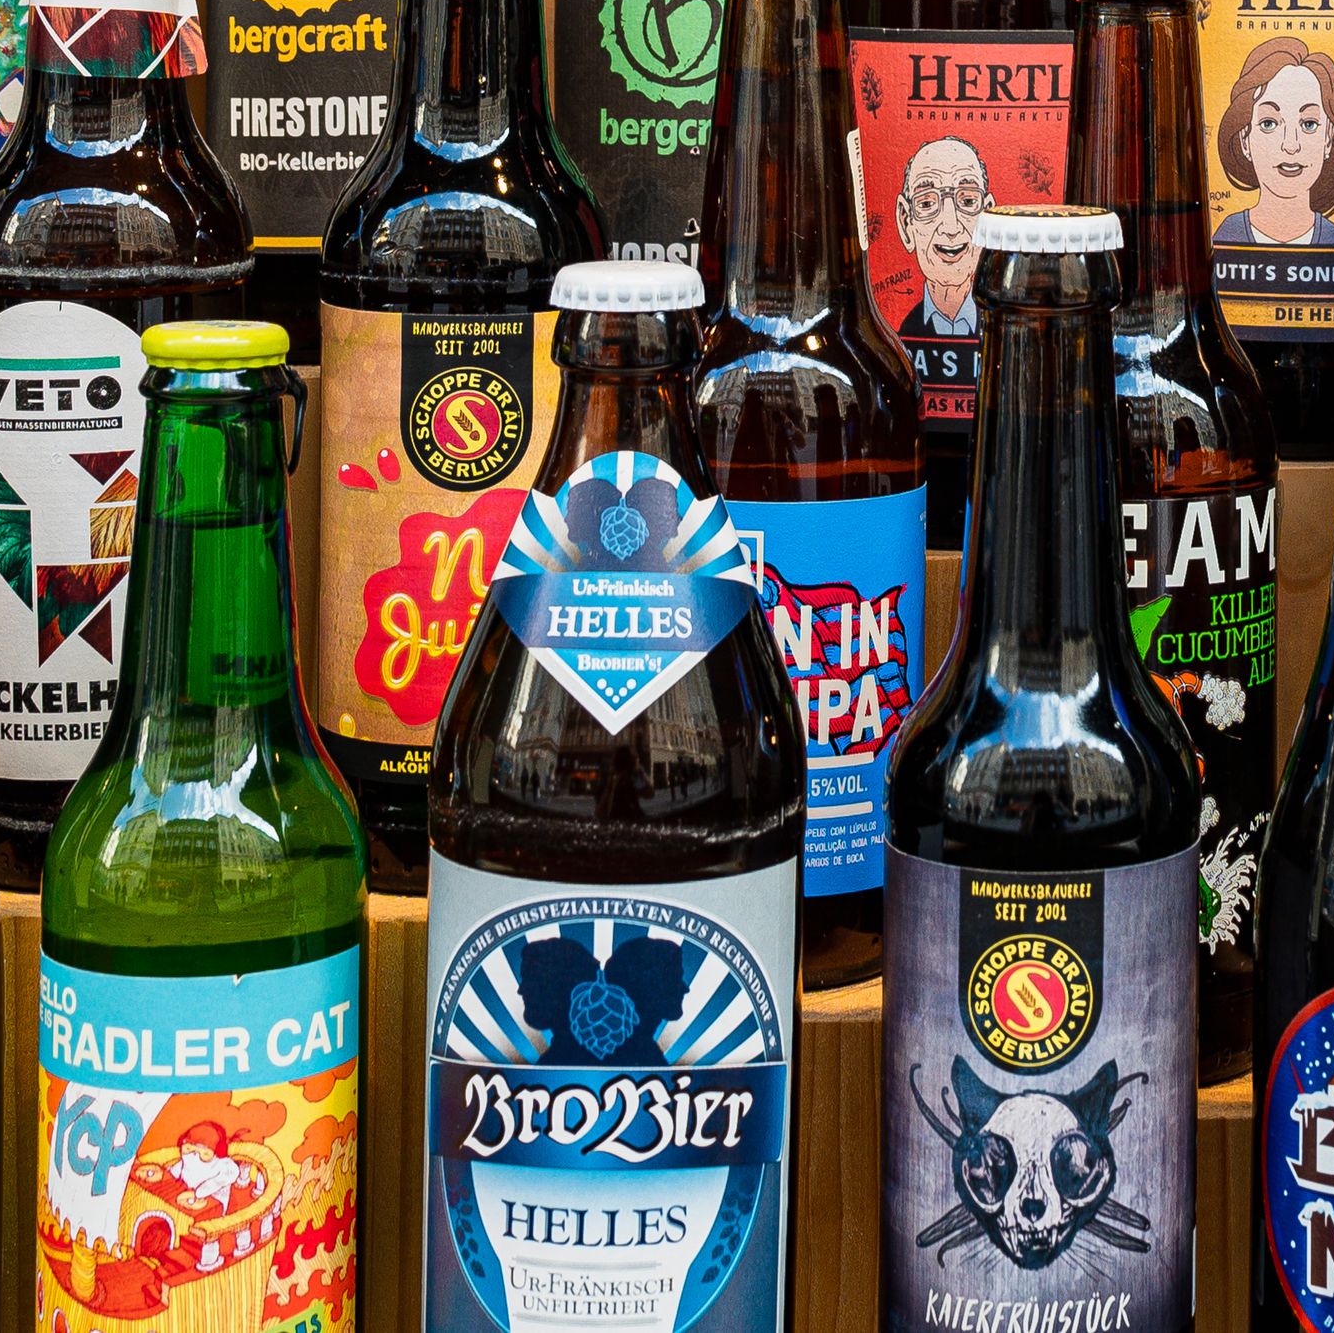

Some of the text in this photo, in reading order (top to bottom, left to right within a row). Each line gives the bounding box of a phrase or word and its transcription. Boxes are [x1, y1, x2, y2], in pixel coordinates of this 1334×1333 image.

[228, 14, 387, 63] bergcraft
[908, 53, 1070, 102] HERTL
[230, 95, 387, 138] FIRESTONE
[413, 322, 524, 335] HANDWERKSBRAUEREI
[1274, 306, 1306, 323] DIE
[435, 339, 501, 356] SEIT 2001
[15, 418, 120, 431] MASSENBIERHALTUNG
[415, 372, 517, 442] SCHOPPE BRÄU
[426, 446, 505, 479] BERLIN
[572, 578, 675, 598] Ur-Fränkisch
[1210, 582, 1276, 627] KILLER
[546, 605, 694, 640] HELLES
[840, 598, 890, 667] IN
[1157, 614, 1276, 665] CUCUMBER
[1248, 648, 1276, 689] ALE
[971, 880, 1092, 899] HANDWERKSBRAUEREI
[995, 903, 1067, 922] SEIT 2001
[440, 898, 774, 1023] FRÄNKISCHE BIERSPEZIALITÄTEN AUS RECKENDORF
[974, 941, 1087, 1018] SCHOPPE BRÄU
[51, 1000, 352, 1078] RADLER CAT
[988, 1028, 1071, 1060] BERLIN
[462, 1072, 755, 1164] BroBier
[501, 1199, 689, 1248] HELLES
[522, 1295, 661, 1316] UNFILTRIERT
[925, 1289, 1132, 1333] KATERFRÜHSTÜCK
